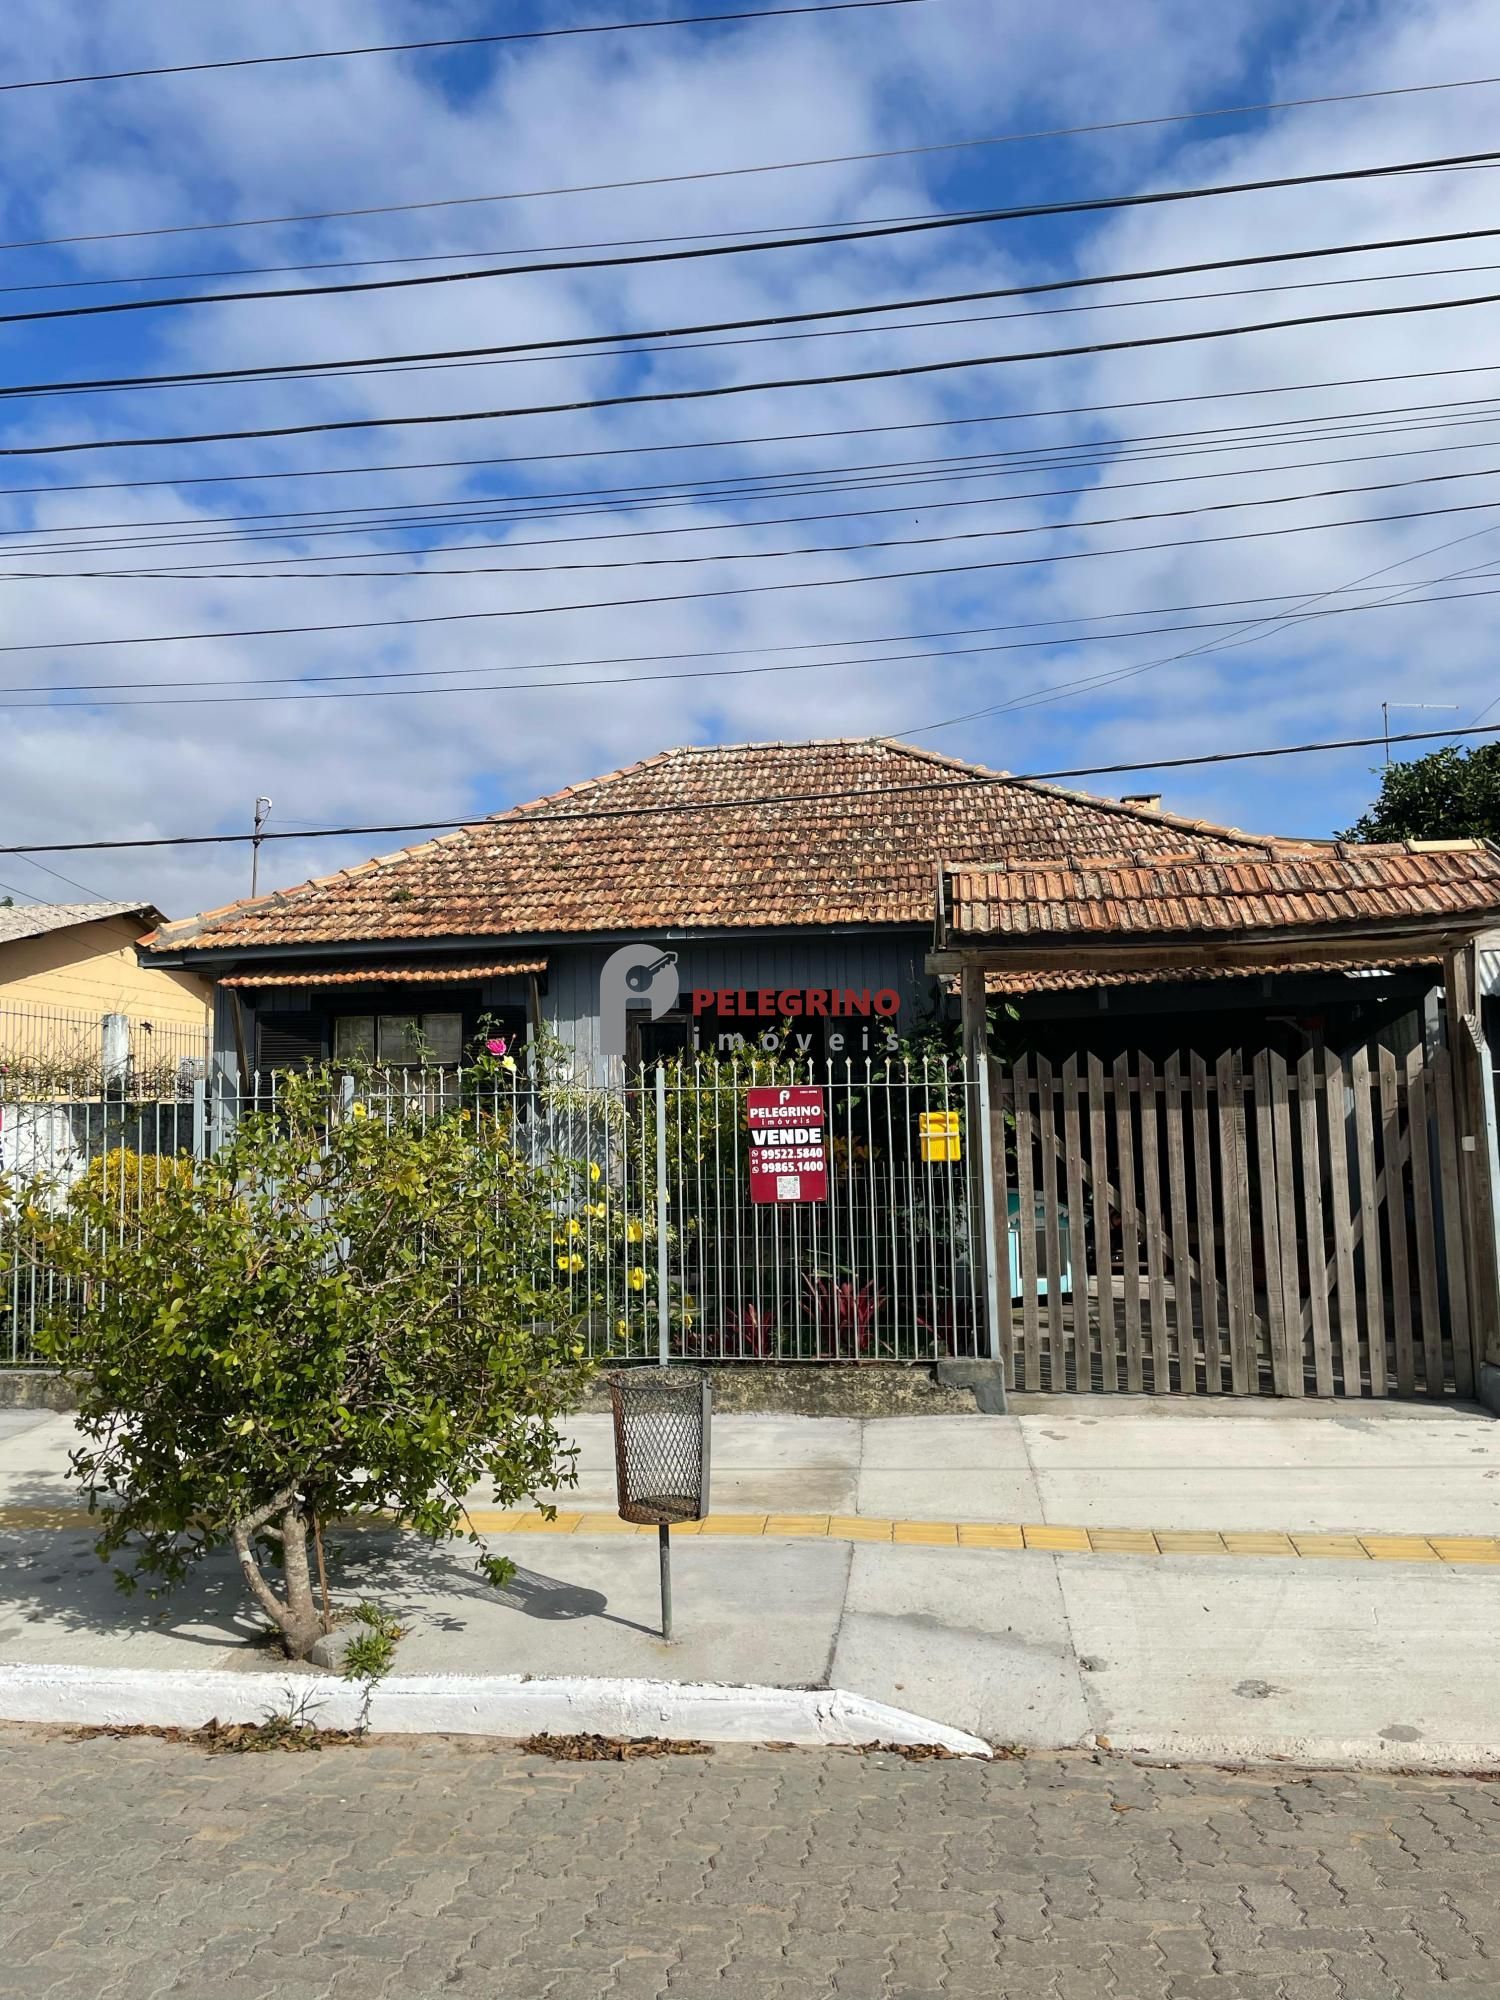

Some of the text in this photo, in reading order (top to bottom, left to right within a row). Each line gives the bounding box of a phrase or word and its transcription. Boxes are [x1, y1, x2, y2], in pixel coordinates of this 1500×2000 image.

[750, 1106, 821, 1118] PELEGRINO
[761, 1117, 810, 1126] imóveis
[751, 1128, 822, 1146] VENDE
[761, 1148, 823, 1160] 99522.5840
[761, 1161, 824, 1173] 99865.1400
